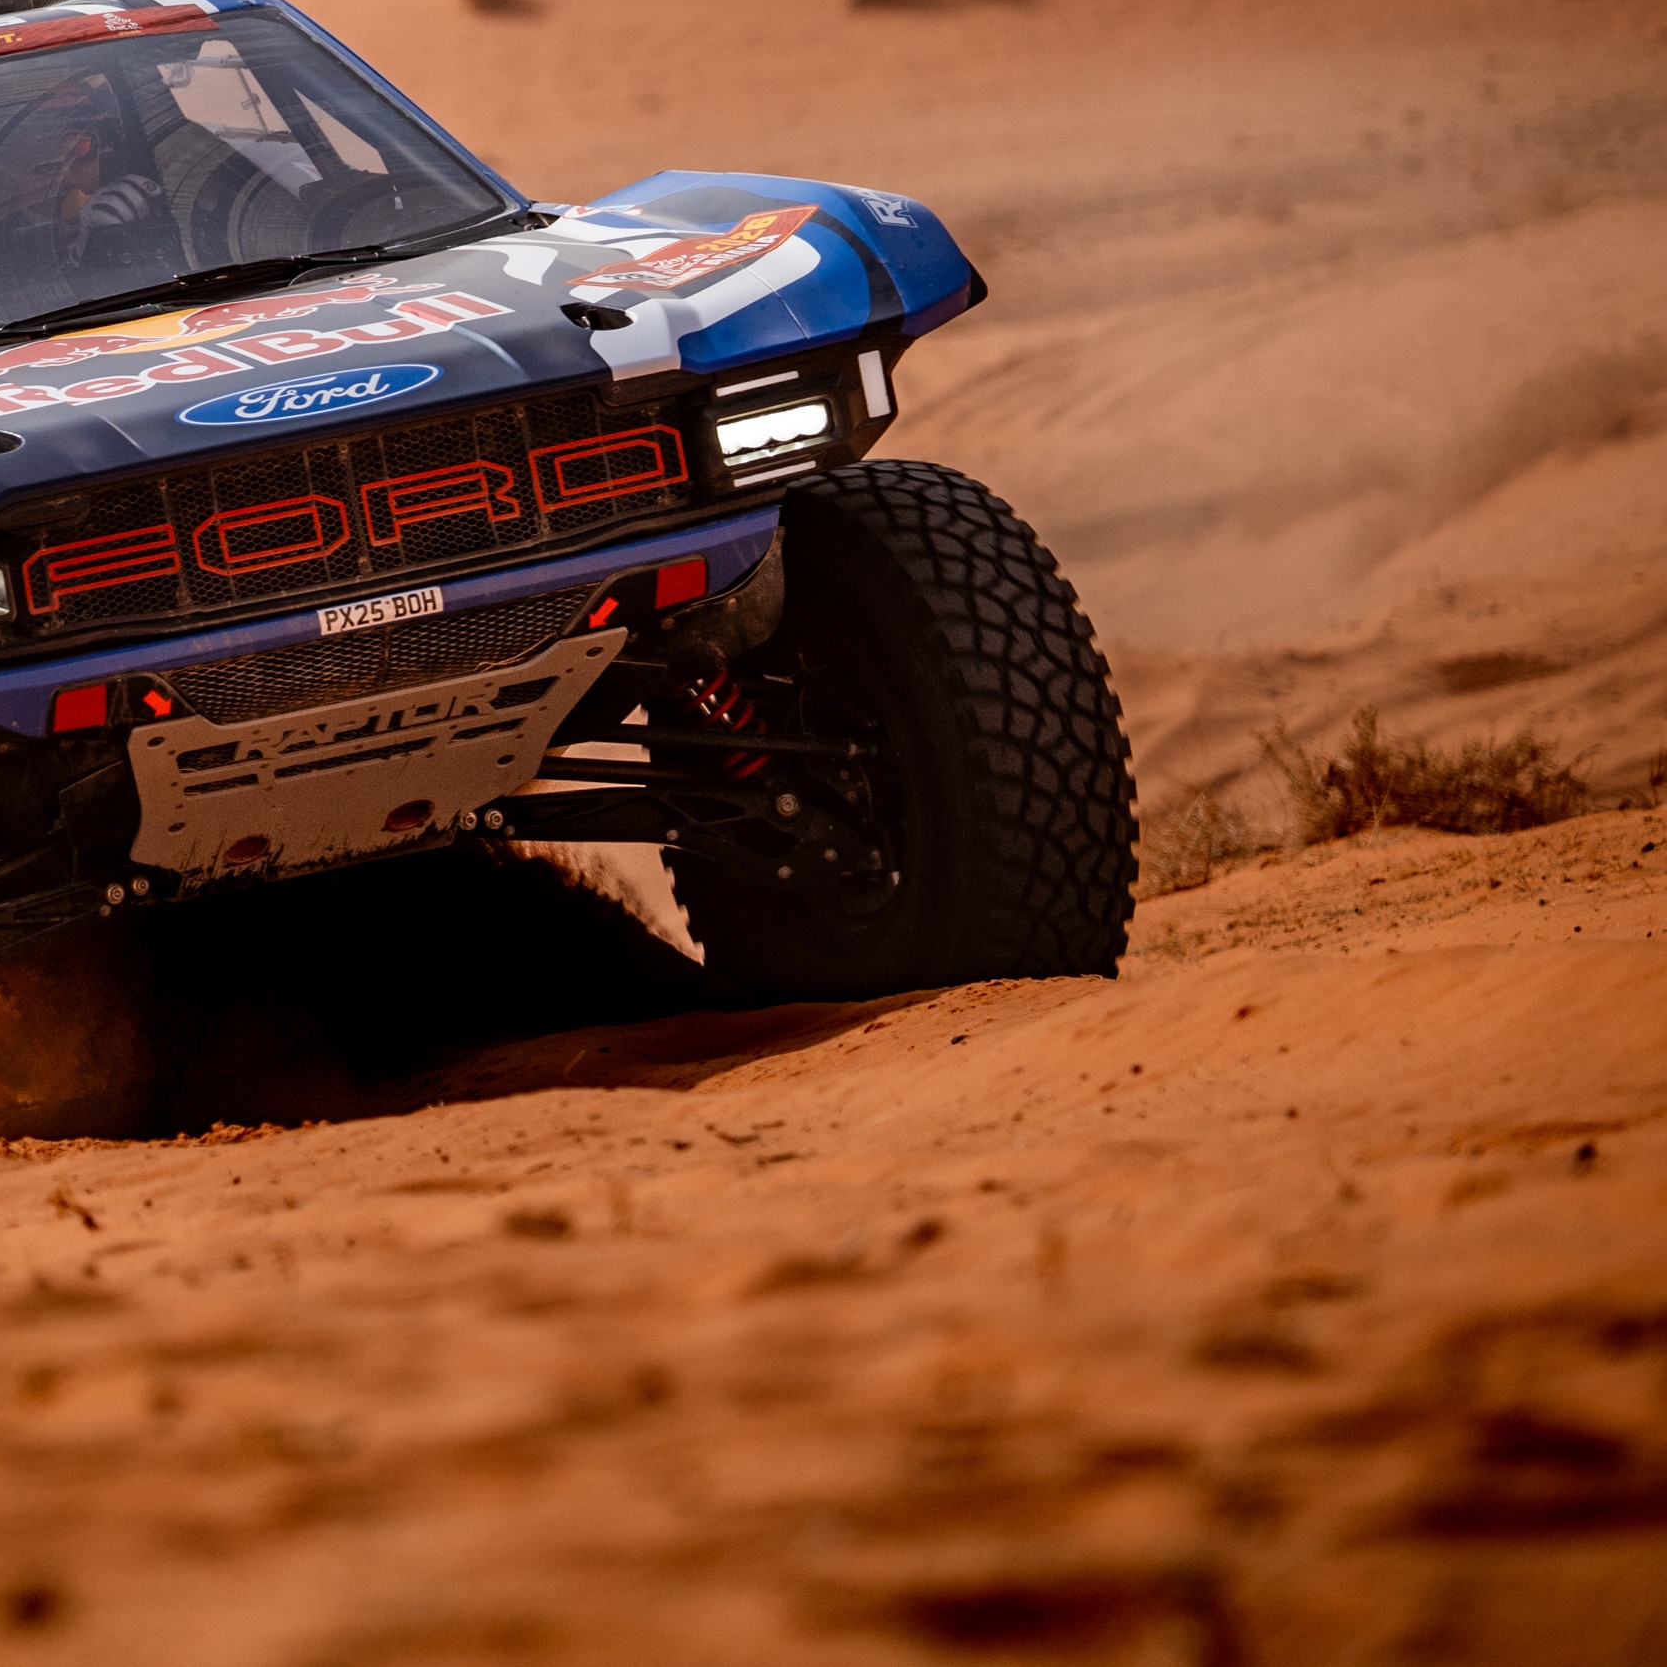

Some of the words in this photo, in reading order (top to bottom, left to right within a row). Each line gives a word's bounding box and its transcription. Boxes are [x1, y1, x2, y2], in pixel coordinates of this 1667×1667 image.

[694, 214, 779, 253] 2026
[707, 234, 781, 269] ARABIA
[218, 291, 515, 365] Bull
[234, 372, 390, 419] Ford
[23, 423, 690, 615] FORD
[324, 600, 385, 632] PX25
[391, 589, 437, 618] BOH
[234, 689, 501, 761] RAPTOR
